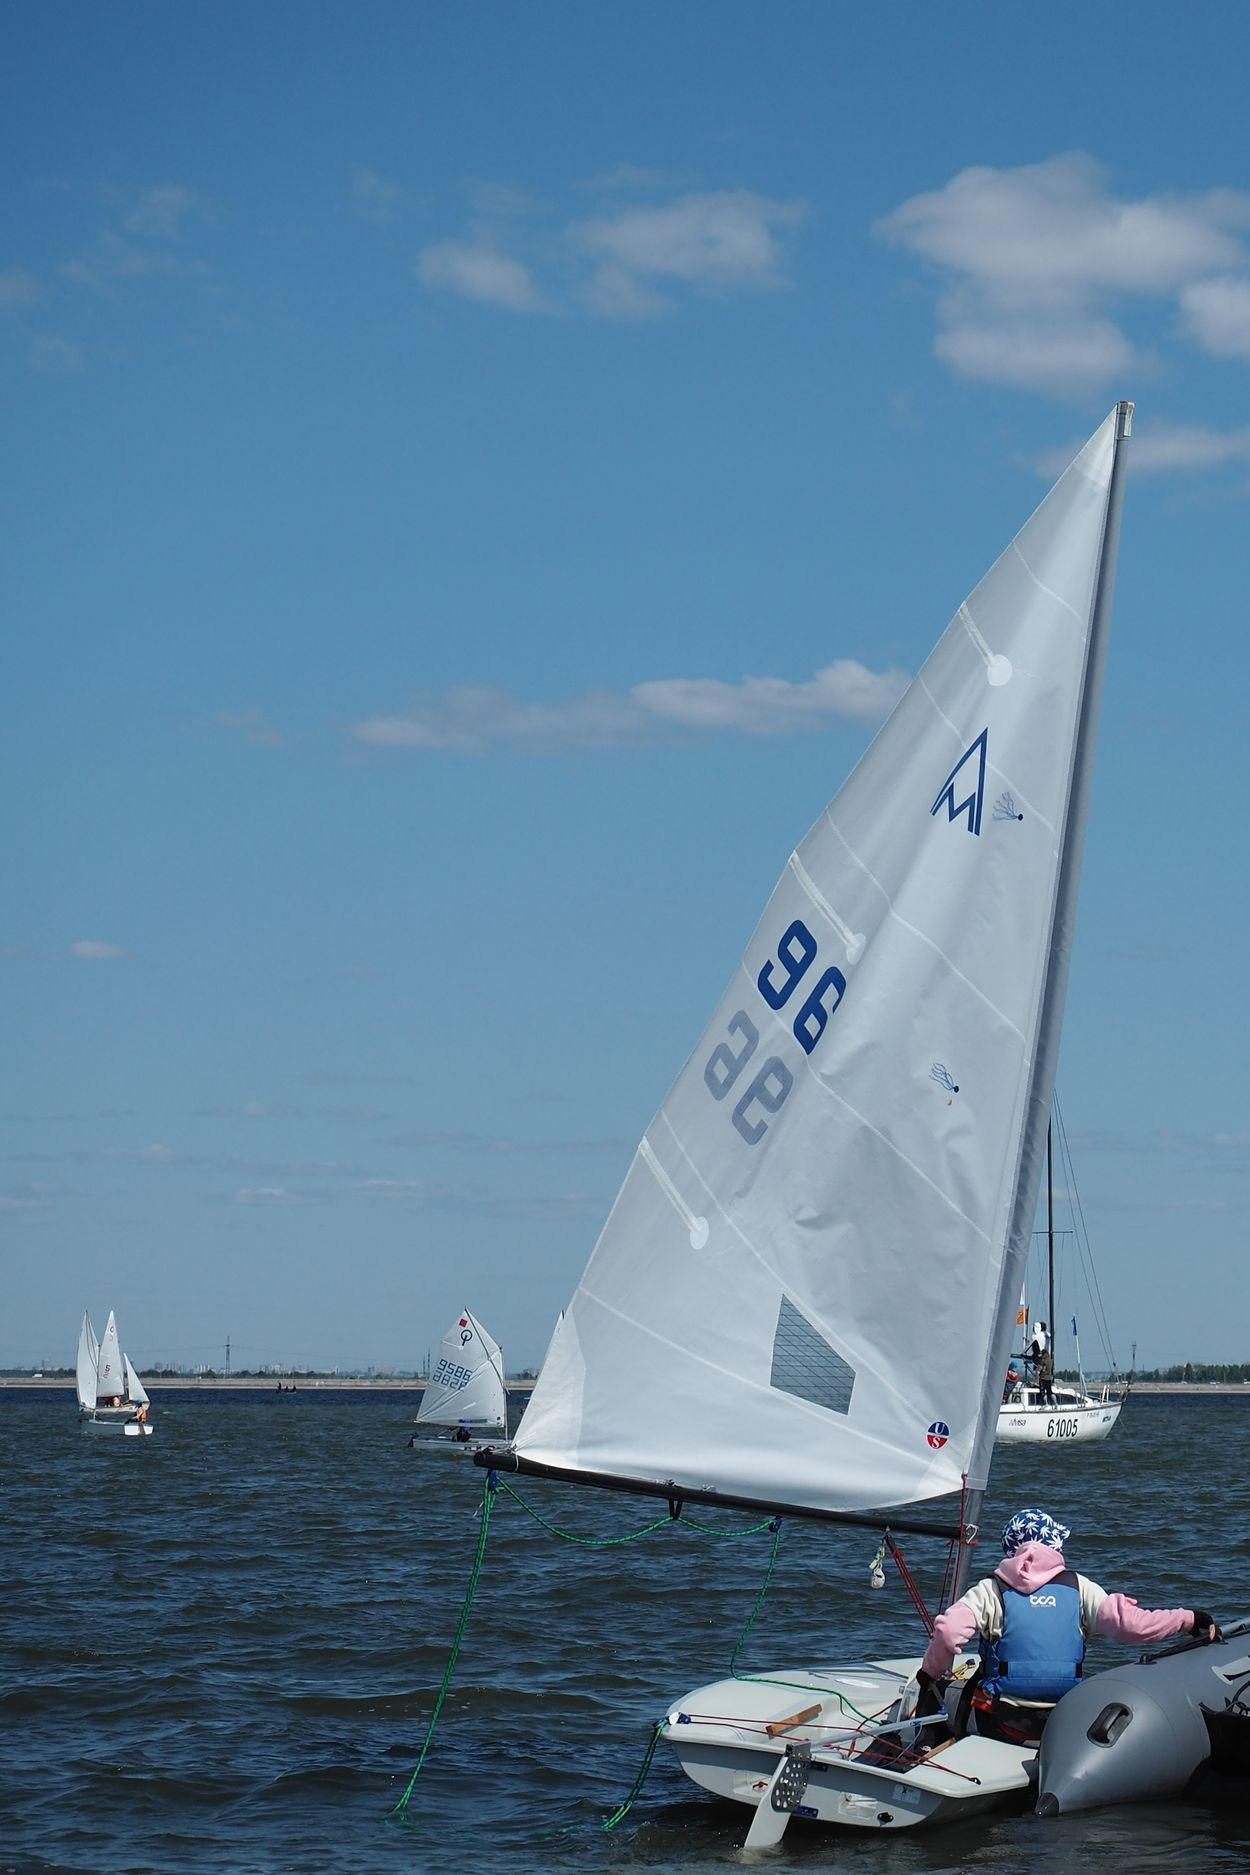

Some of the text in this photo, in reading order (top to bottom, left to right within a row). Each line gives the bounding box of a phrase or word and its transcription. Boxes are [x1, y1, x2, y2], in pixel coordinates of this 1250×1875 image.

[757, 919, 847, 1056] 96
[437, 1358, 473, 1381] 9586
[1047, 1418, 1079, 1438] 61005
